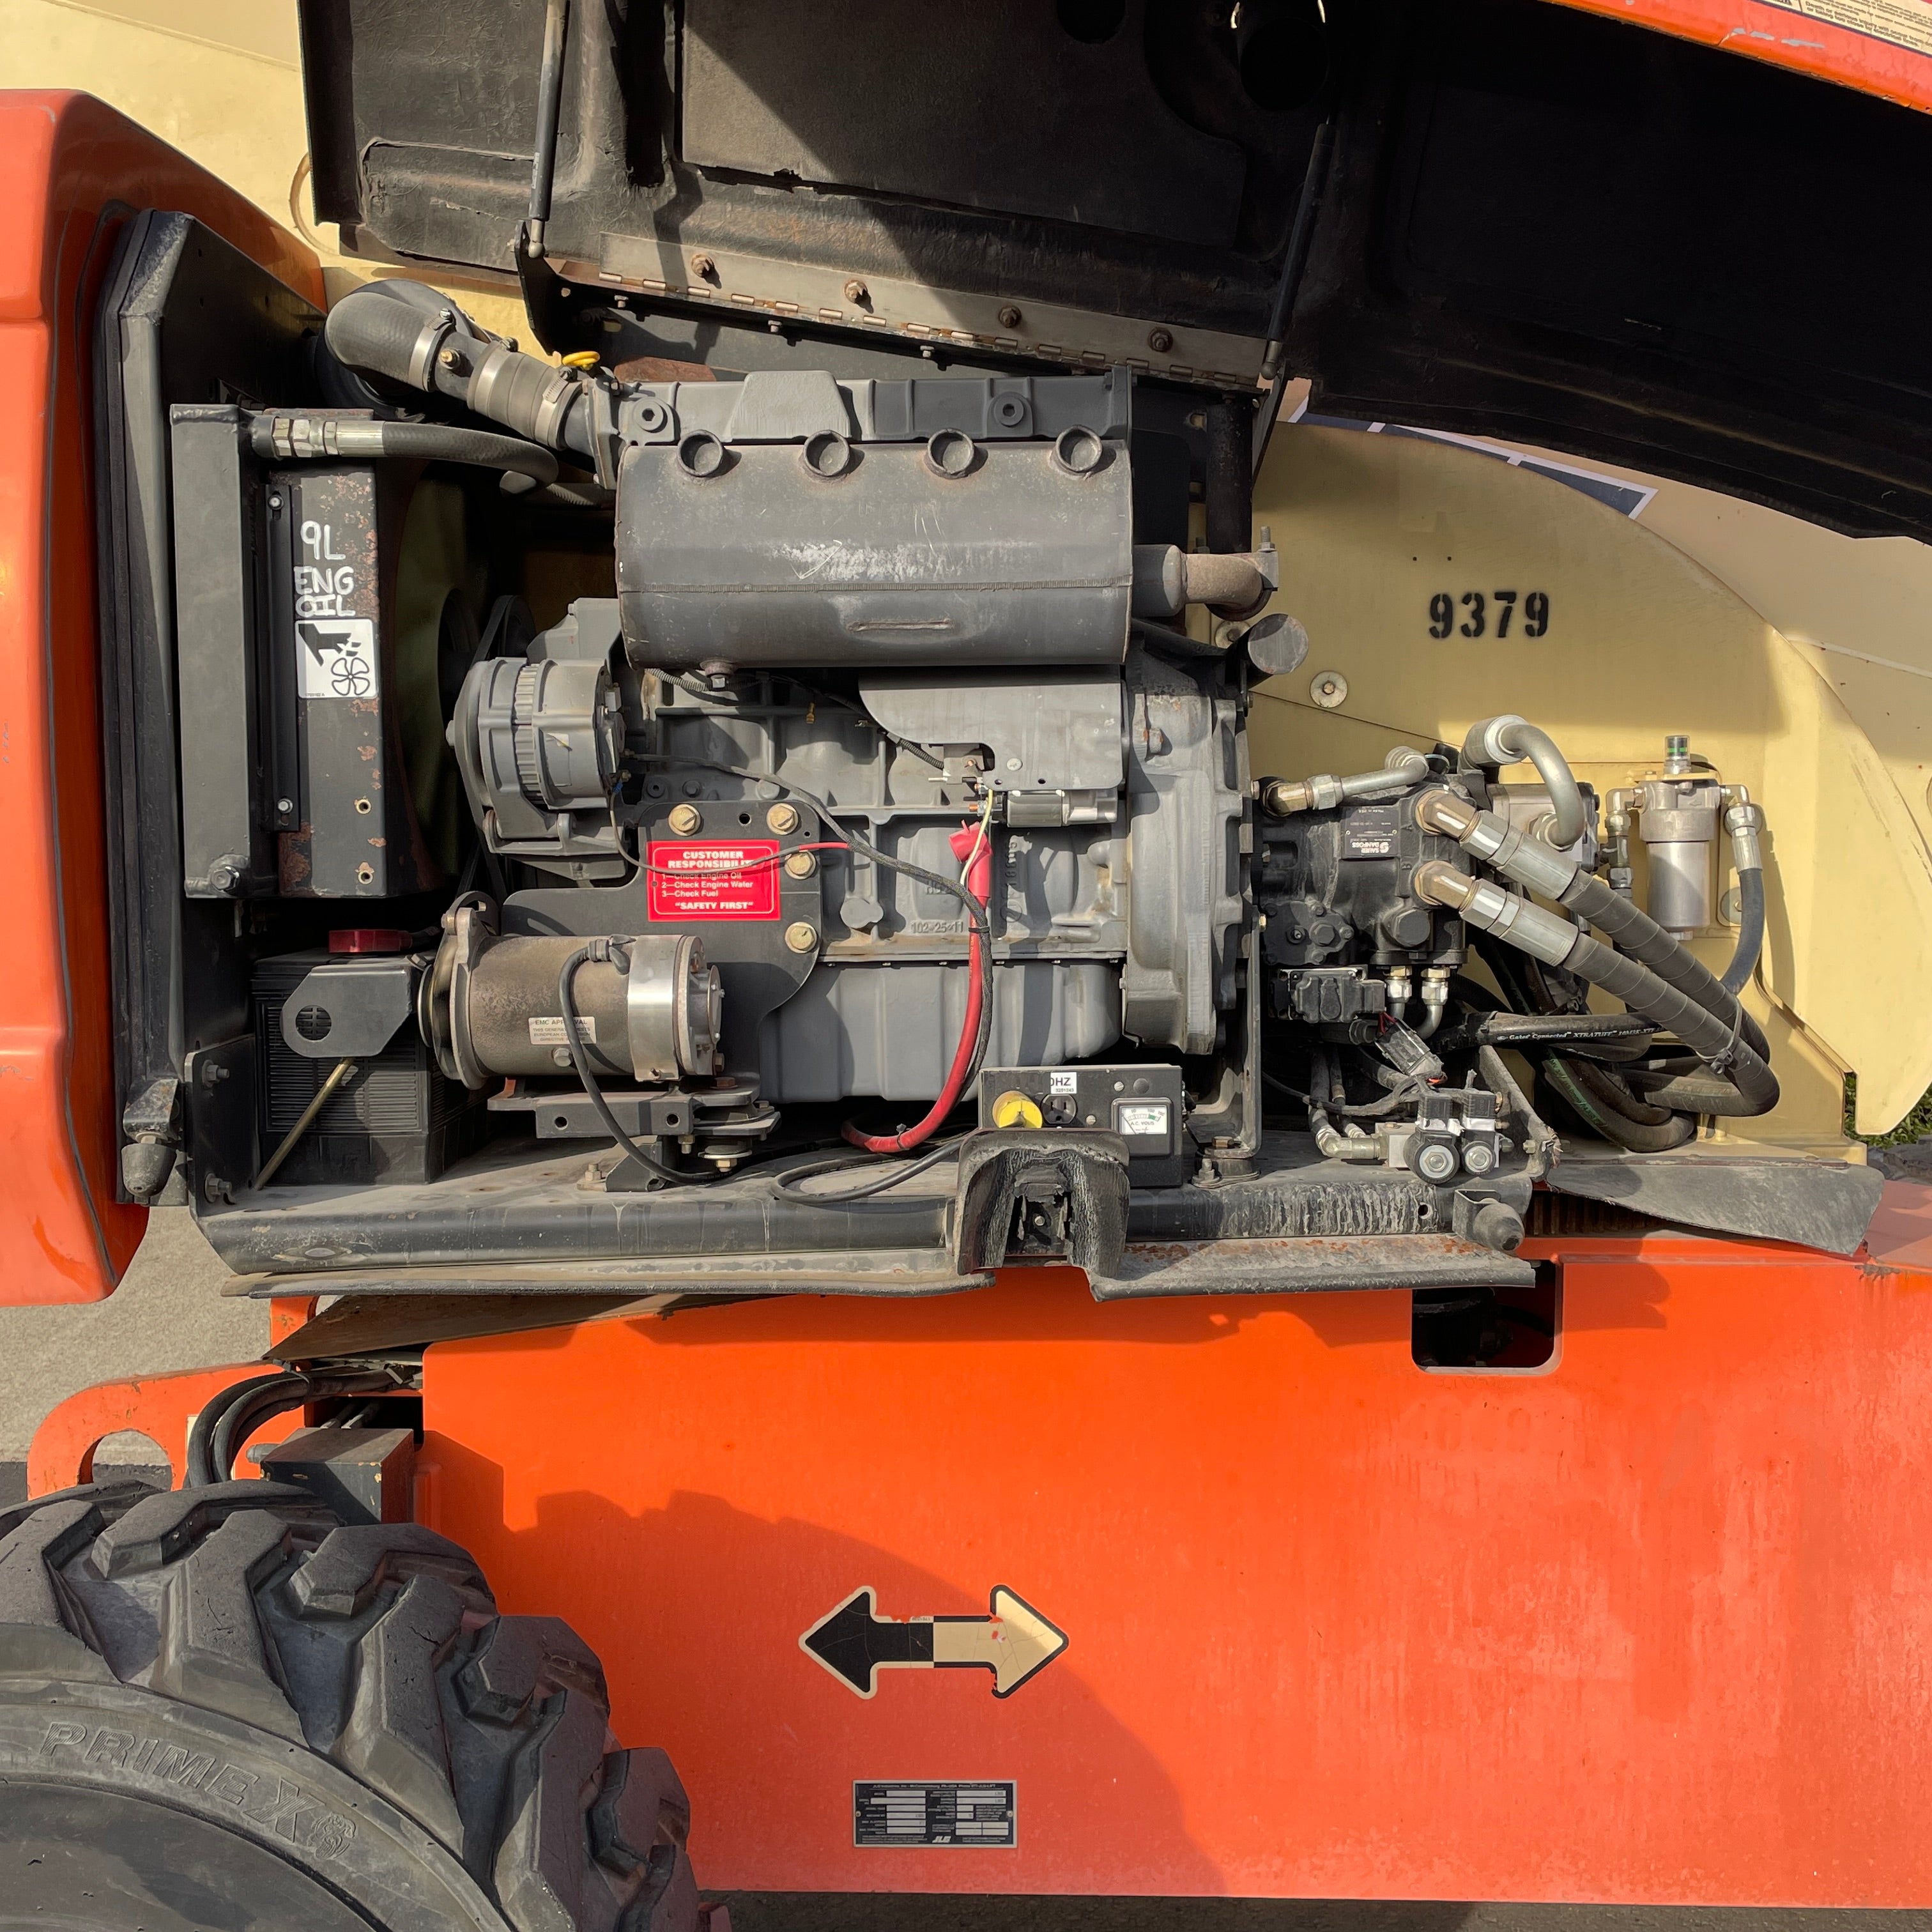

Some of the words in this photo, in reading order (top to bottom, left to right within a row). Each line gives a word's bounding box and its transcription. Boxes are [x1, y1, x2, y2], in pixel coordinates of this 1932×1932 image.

[300, 520, 346, 560] 9L
[294, 566, 355, 595] ENG
[295, 594, 355, 617] OIL
[1429, 592, 1549, 638] 9379
[701, 872, 729, 882] Engine
[730, 871, 742, 880] Oil
[701, 881, 729, 890] Engine
[39, 1721, 326, 1843] PRIMEX
